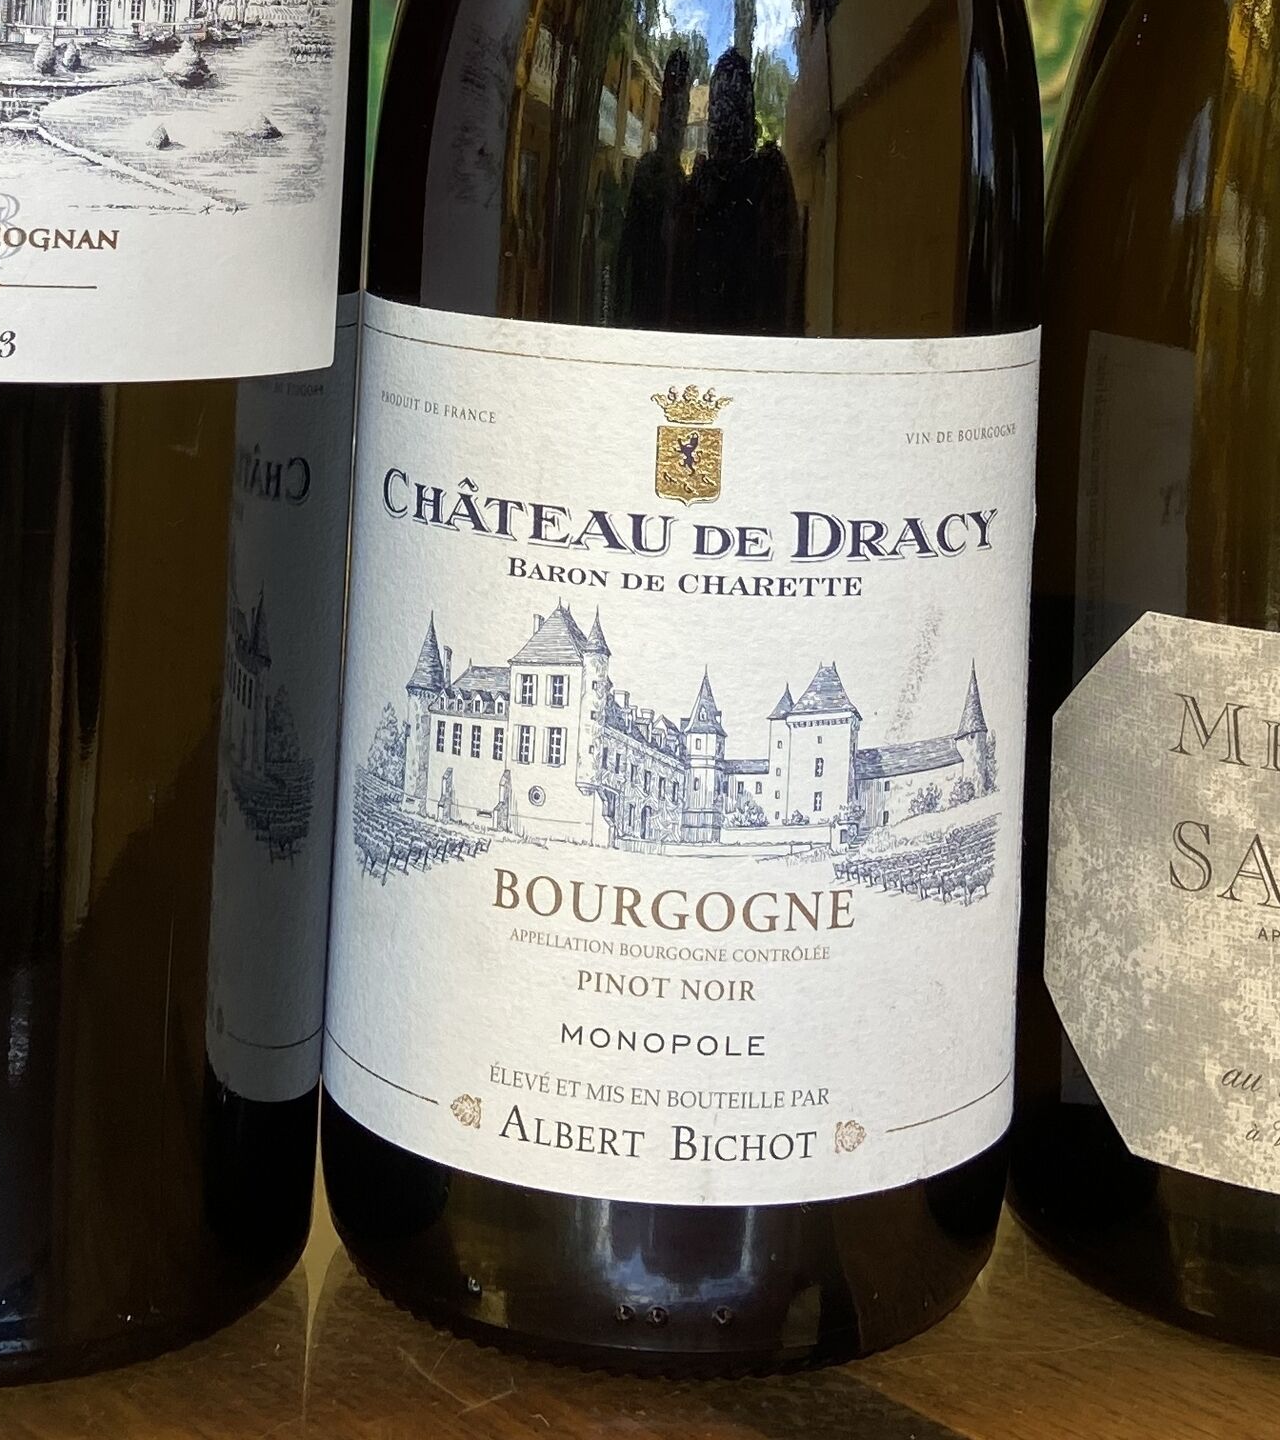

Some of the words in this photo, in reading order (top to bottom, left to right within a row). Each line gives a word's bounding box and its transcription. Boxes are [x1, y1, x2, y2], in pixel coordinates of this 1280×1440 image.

[381, 390, 420, 411] PRODUIT
[424, 401, 439, 415] DE
[443, 404, 497, 424] FRANCE
[905, 432, 931, 444] VIN
[936, 431, 953, 443] DE
[958, 422, 1016, 442] BOURGOGNE
[382, 466, 676, 558] CHÂTEAU
[691, 522, 775, 562] DE
[790, 507, 999, 563] DRACY
[506, 555, 610, 588] BARON
[621, 570, 666, 592] DE
[677, 572, 863, 598] CHARETTE
[493, 867, 856, 934] BOURGOGNE
[509, 927, 614, 955] APPELLATION
[619, 942, 727, 962] BOURGOGNE
[732, 944, 831, 963] CONTRÔLÉE
[577, 969, 671, 999] PINOT
[680, 979, 756, 1001] NOIR
[559, 1022, 766, 1058] MONOPOLE
[489, 1060, 551, 1094] ÉLEVÉ
[556, 1079, 581, 1098] ET
[586, 1082, 625, 1104] MIS
[630, 1087, 661, 1107] EN
[666, 1090, 785, 1110] BOUTEILLE
[790, 1087, 830, 1107] PAR
[1220, 1067, 1264, 1092] au
[498, 1104, 646, 1158] ALBERT
[670, 1124, 818, 1162] BICHOT
[1245, 1122, 1261, 1142] à
